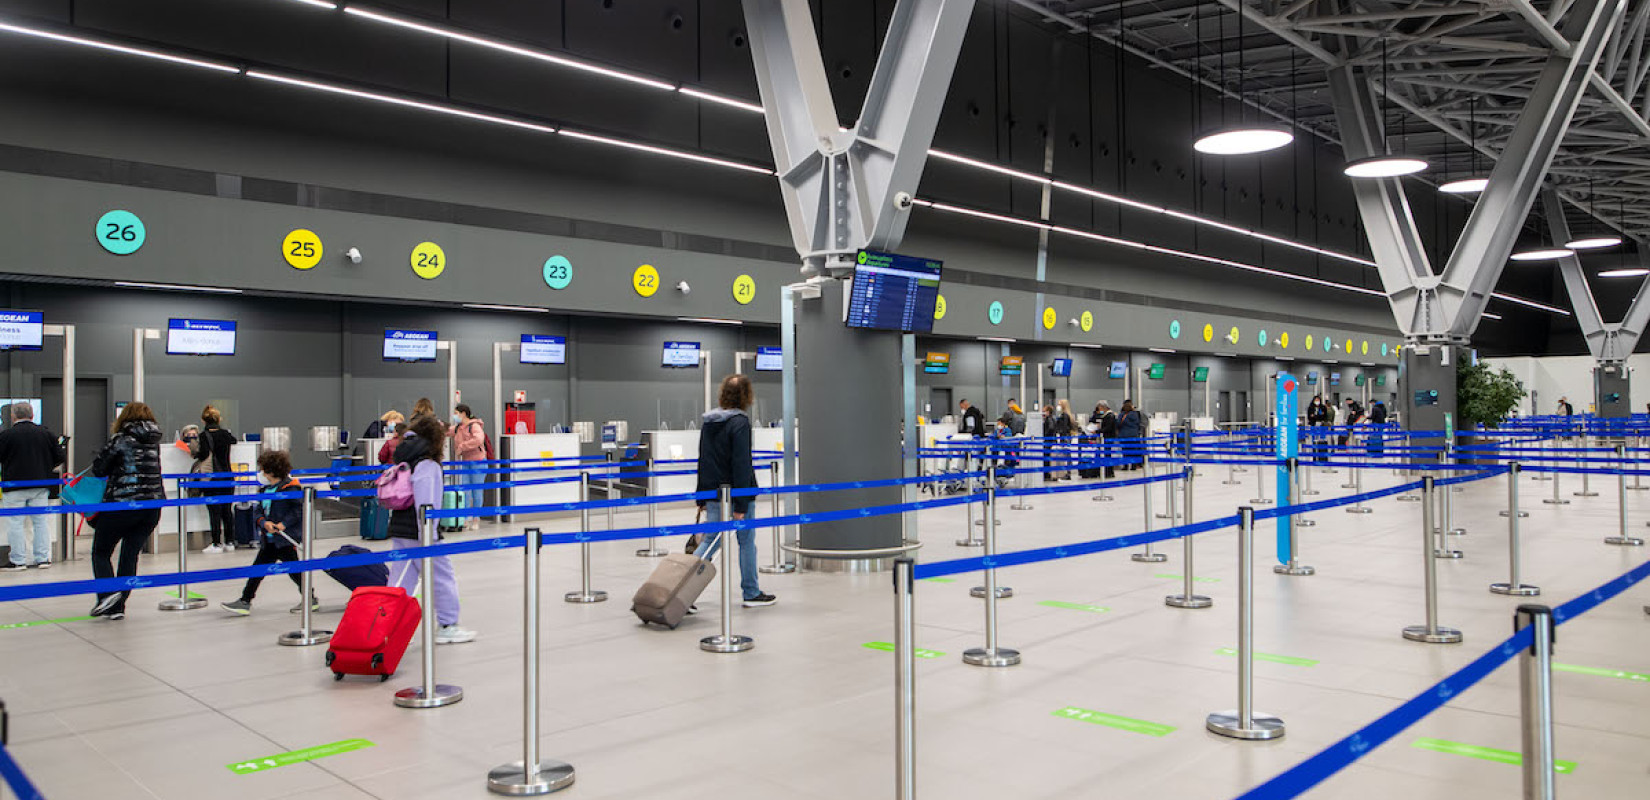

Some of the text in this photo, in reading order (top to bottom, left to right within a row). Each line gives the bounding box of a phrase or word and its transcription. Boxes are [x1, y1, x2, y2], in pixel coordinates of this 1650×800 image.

[106, 223, 136, 241] 26
[290, 241, 315, 257] 25
[417, 252, 439, 268] 24
[549, 264, 567, 279] 23
[638, 274, 654, 287] 22
[738, 283, 750, 295] 21
[0, 314, 30, 322] EGEAN
[992, 308, 1000, 318] 17
[1280, 426, 1288, 458] AEGEAN
